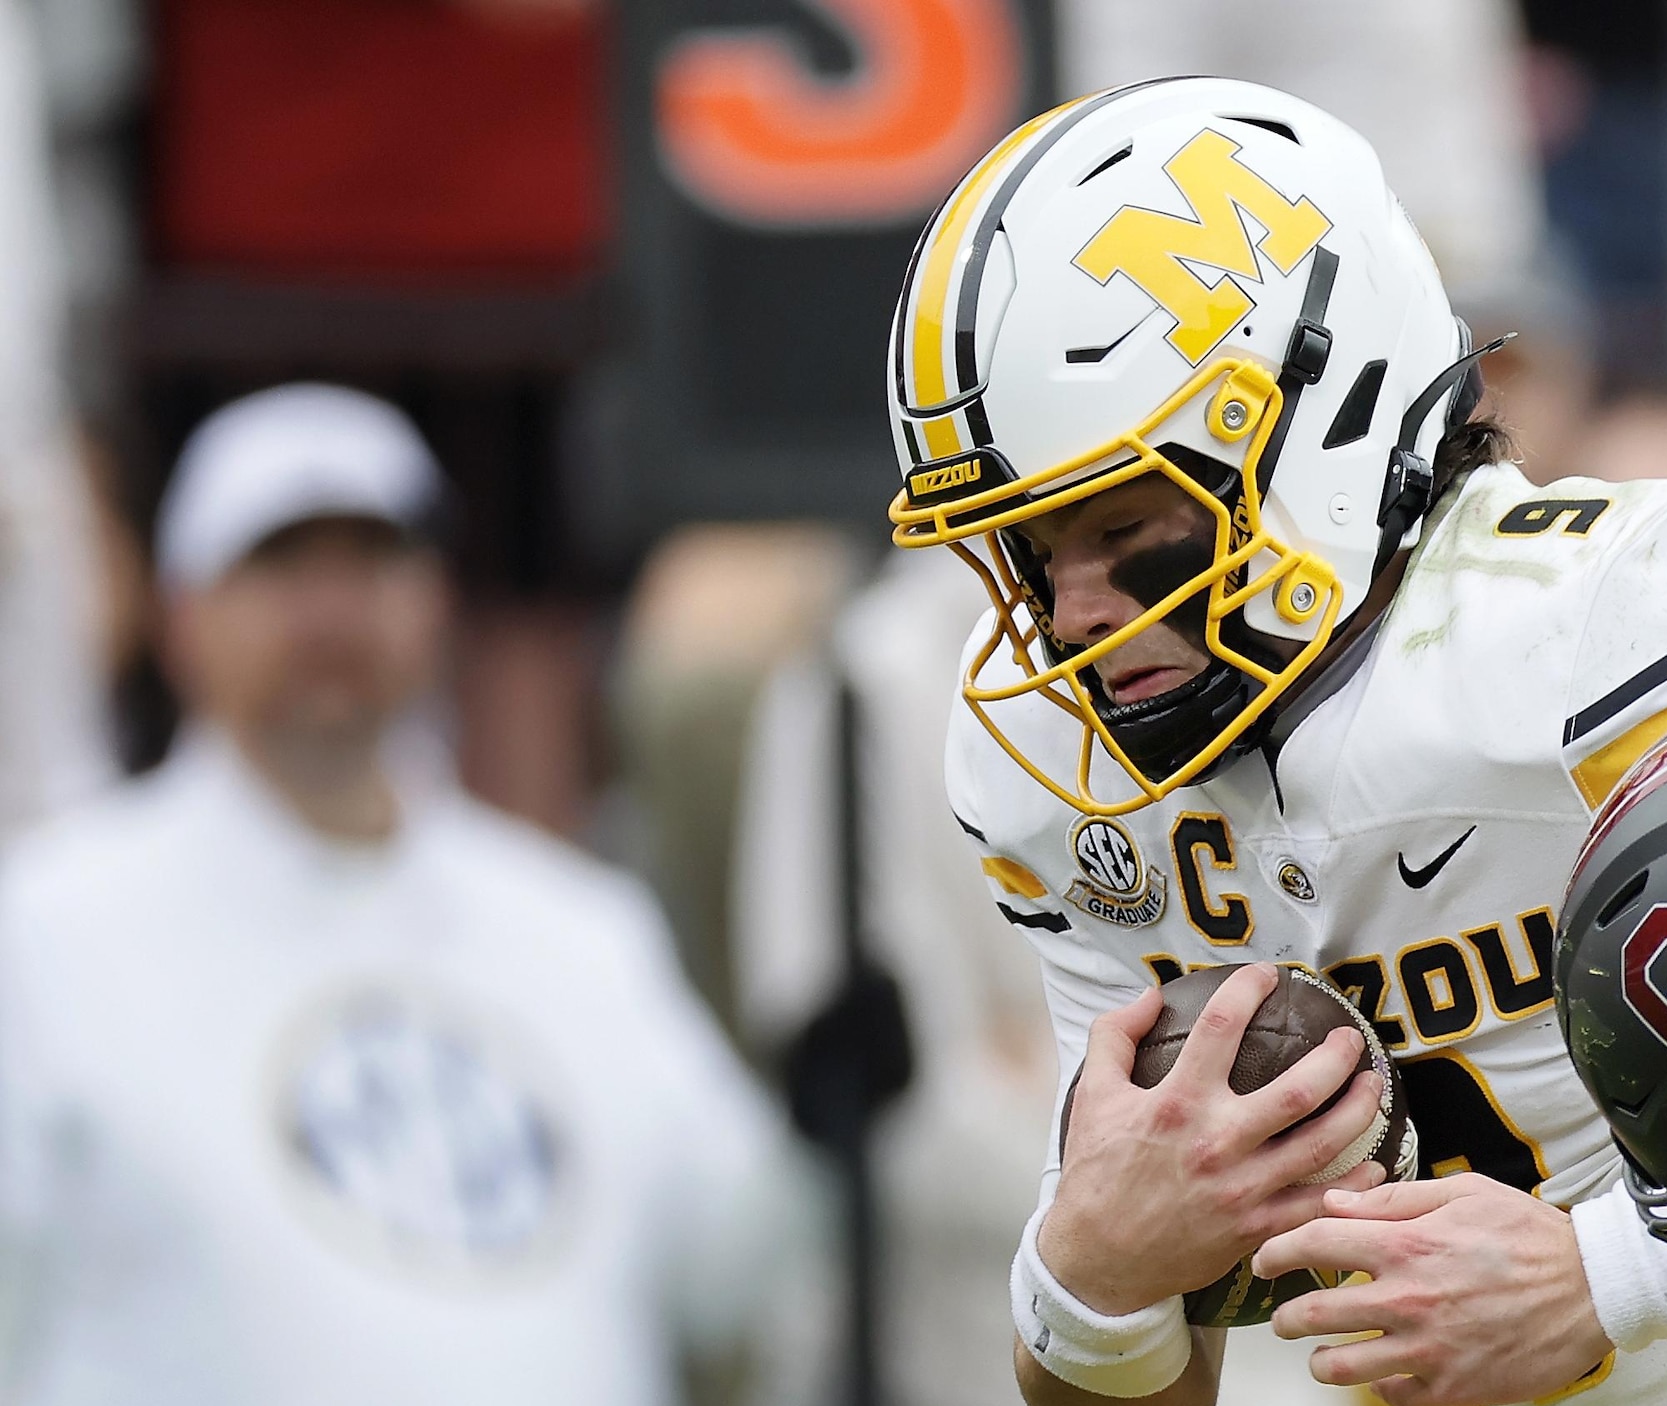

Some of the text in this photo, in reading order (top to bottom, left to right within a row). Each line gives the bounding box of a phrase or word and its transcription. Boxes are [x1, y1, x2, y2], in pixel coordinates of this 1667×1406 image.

[1071, 128, 1334, 366] M
[1493, 498, 1614, 538] 9
[1076, 822, 1138, 891] SEC
[1169, 810, 1256, 946] C
[1087, 891, 1162, 925] GRADUATE
